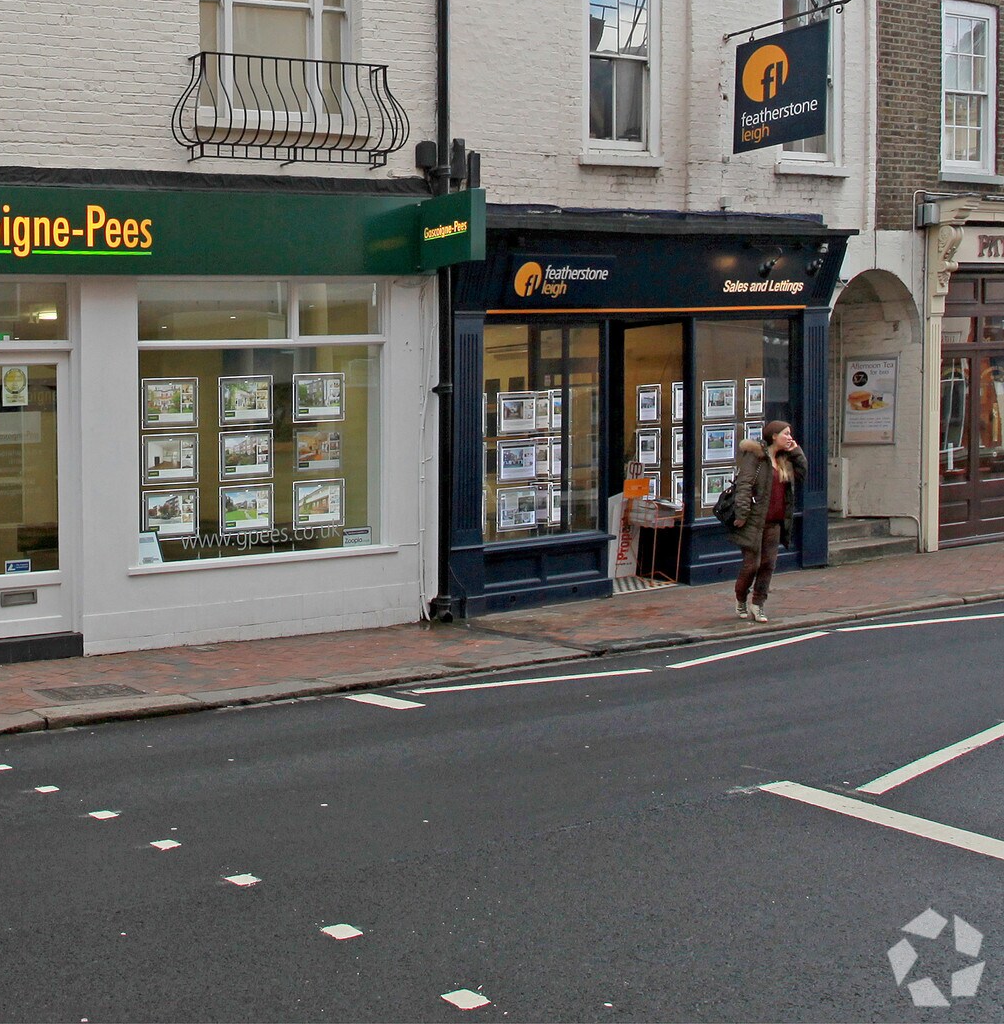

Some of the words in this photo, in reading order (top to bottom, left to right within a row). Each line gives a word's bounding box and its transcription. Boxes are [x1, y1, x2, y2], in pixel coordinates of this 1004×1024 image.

[741, 99, 818, 127] featherstone
[741, 123, 770, 143] leigh
[424, 220, 468, 238] Gascoigne-Pees
[544, 264, 609, 280] featherstone
[541, 280, 567, 298] leigh
[723, 280, 749, 293] Sales
[749, 280, 769, 292] and
[768, 279, 804, 295] Lettings
[181, 518, 341, 551] www.gpees.co.uk
